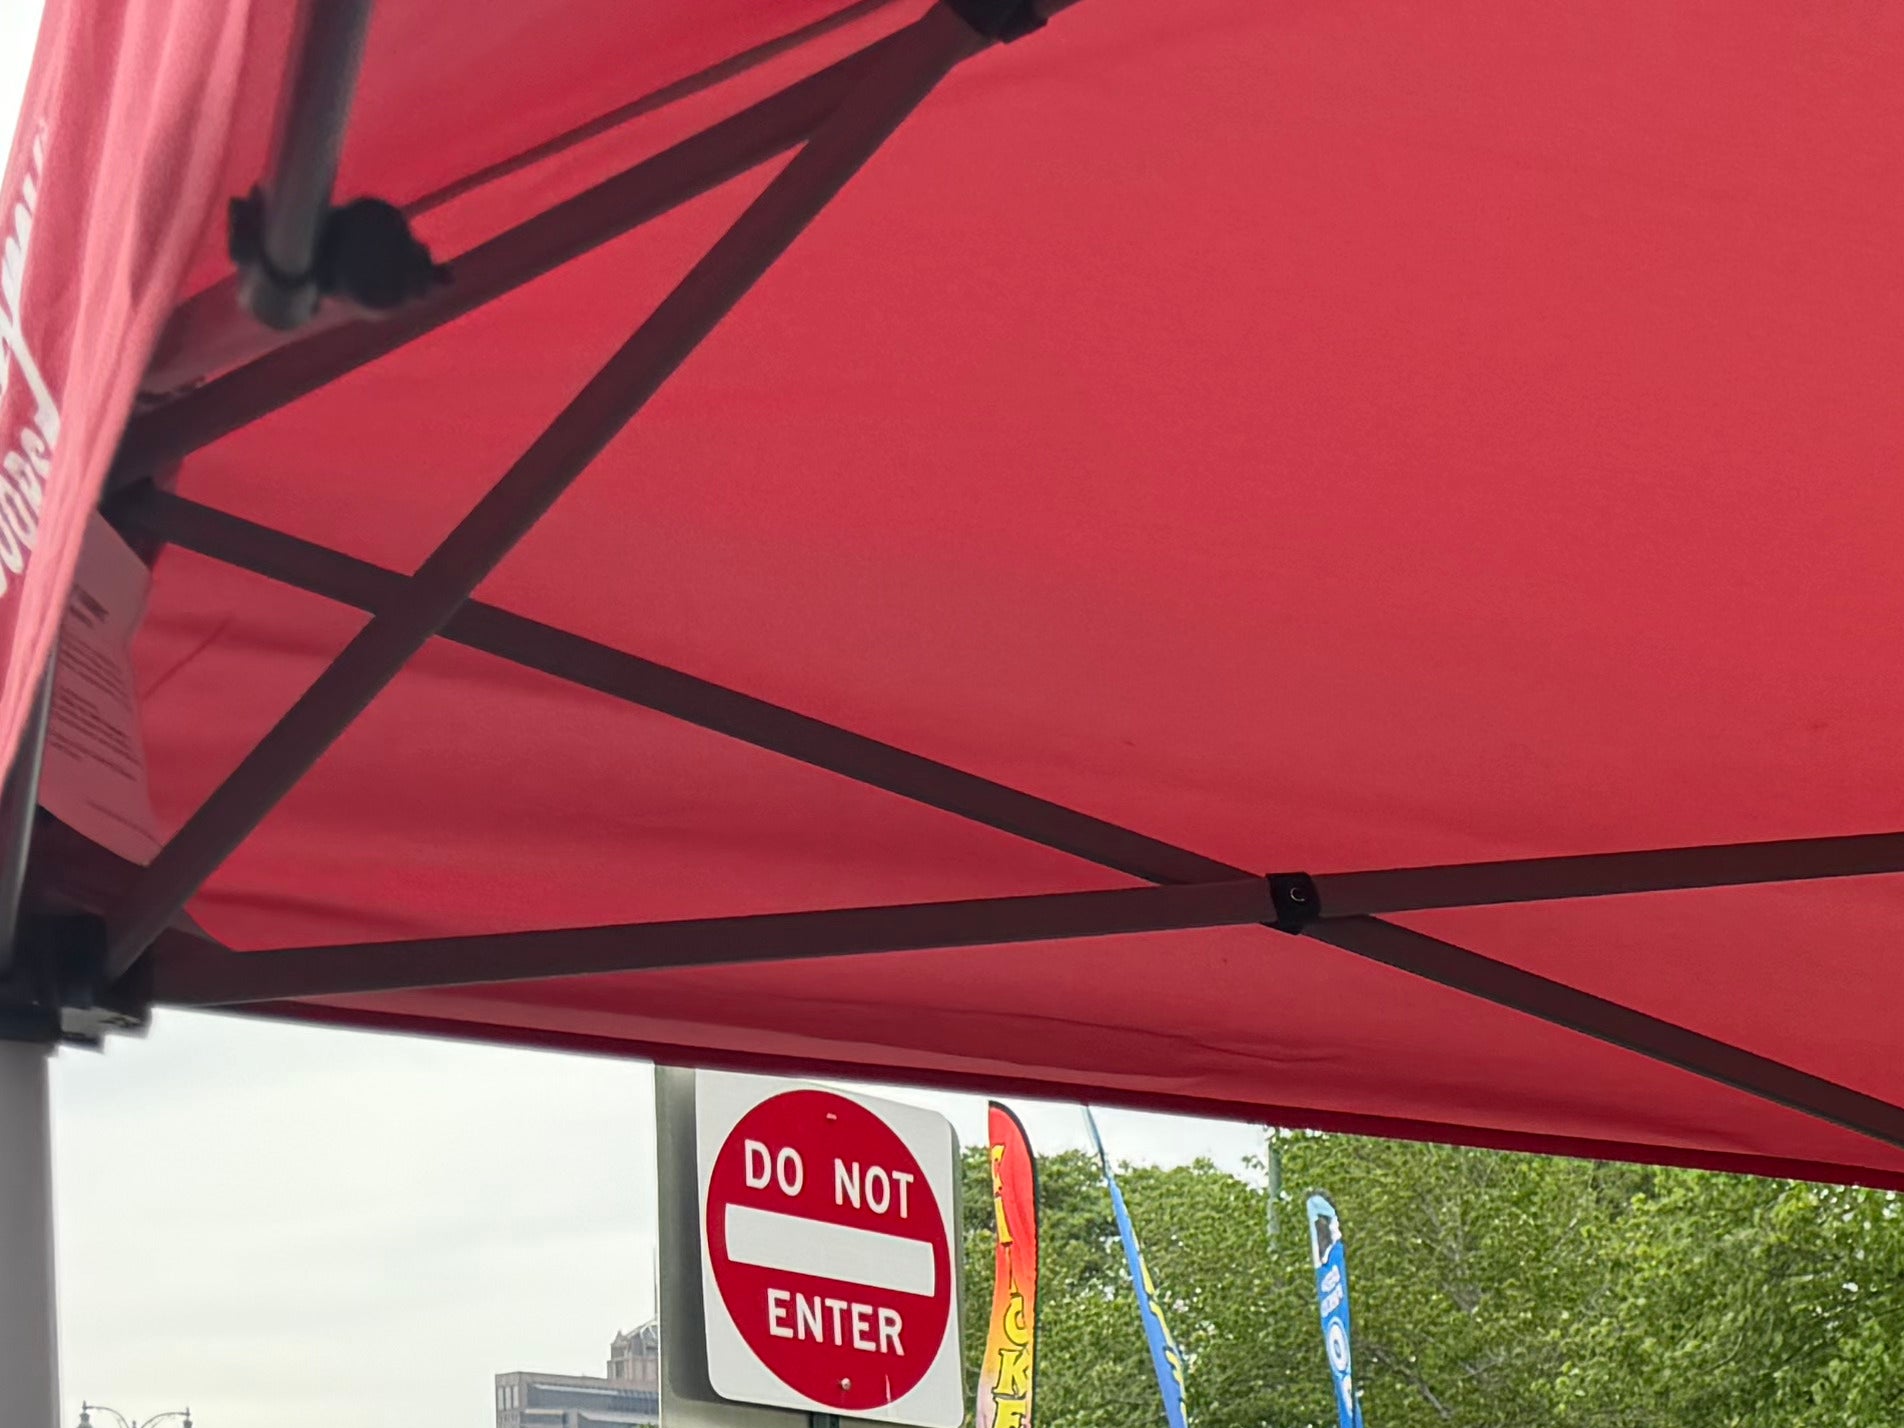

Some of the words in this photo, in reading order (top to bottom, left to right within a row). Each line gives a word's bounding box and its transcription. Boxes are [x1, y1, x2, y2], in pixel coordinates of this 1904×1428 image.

[744, 1138, 804, 1197] DO
[834, 1157, 914, 1219] NOT
[767, 1288, 905, 1356] ENTER
